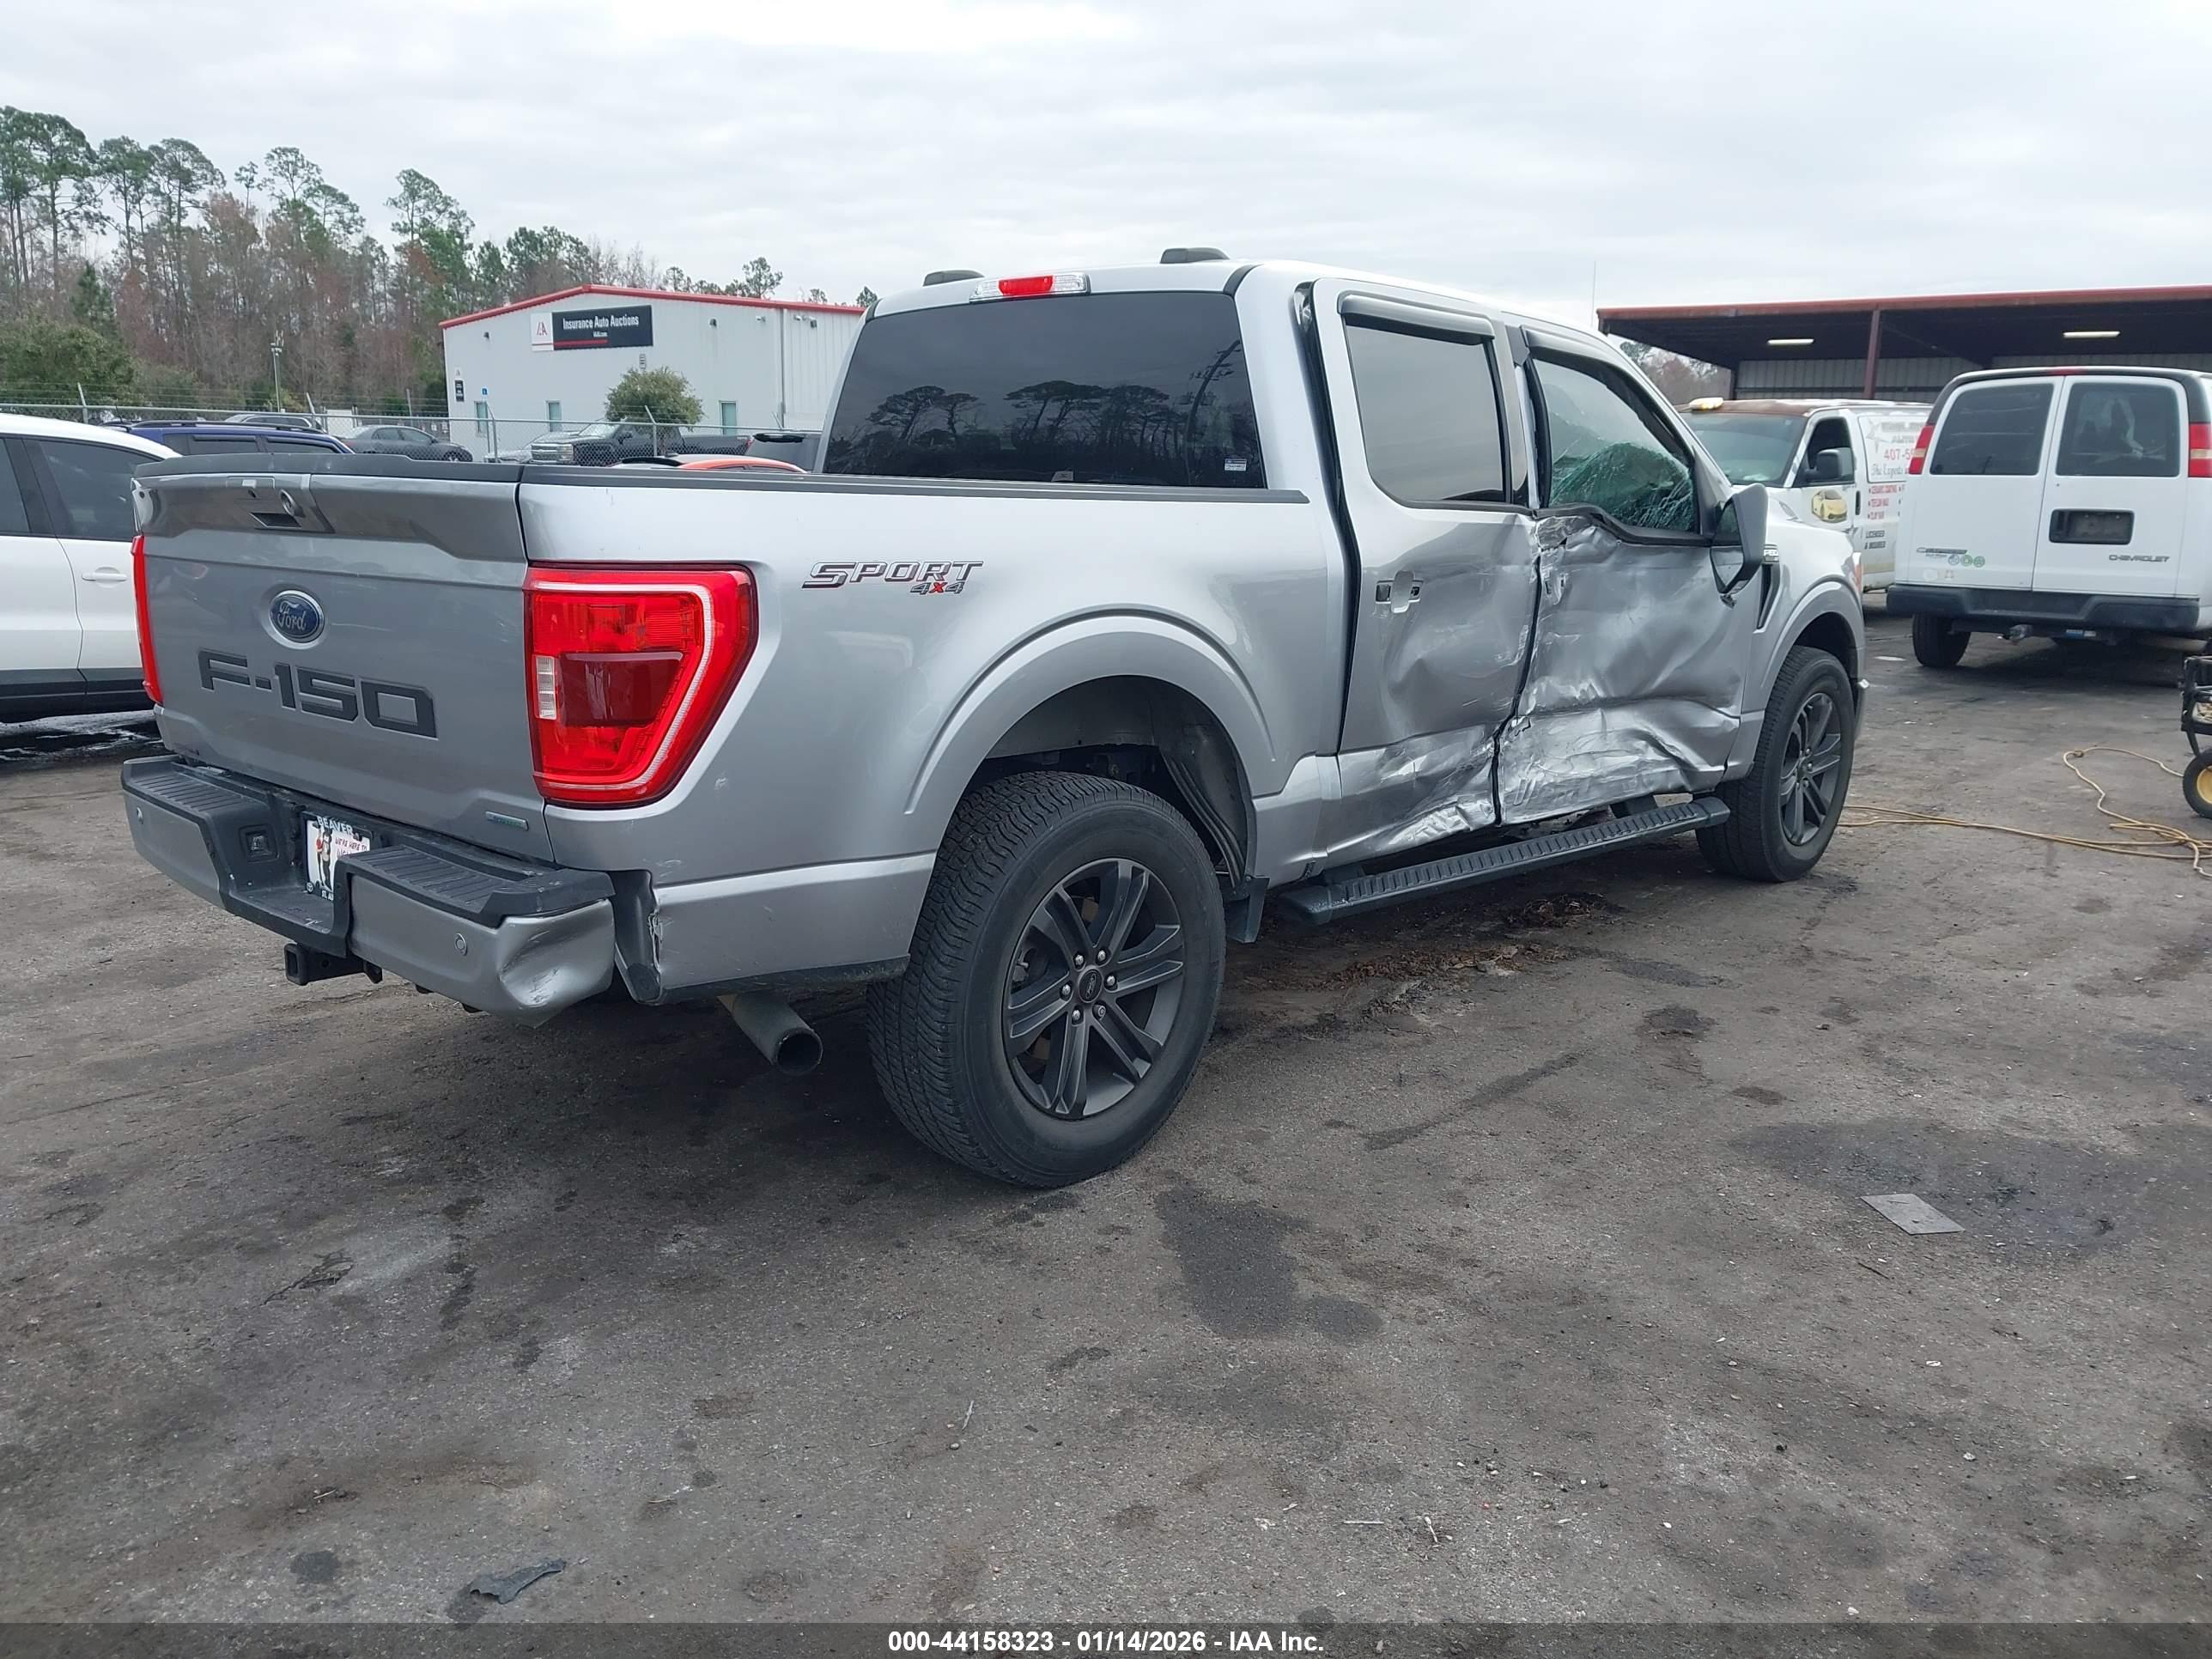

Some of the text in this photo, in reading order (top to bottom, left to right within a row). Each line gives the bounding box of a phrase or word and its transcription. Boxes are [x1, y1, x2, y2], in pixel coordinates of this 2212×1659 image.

[562, 313, 640, 331] Insurance Auto Auctions
[2109, 554, 2170, 562] CHEVROLET
[802, 561, 984, 589] SPORT
[277, 600, 307, 630] Ford
[198, 648, 438, 739] F-150
[316, 816, 353, 836] BEAVER
